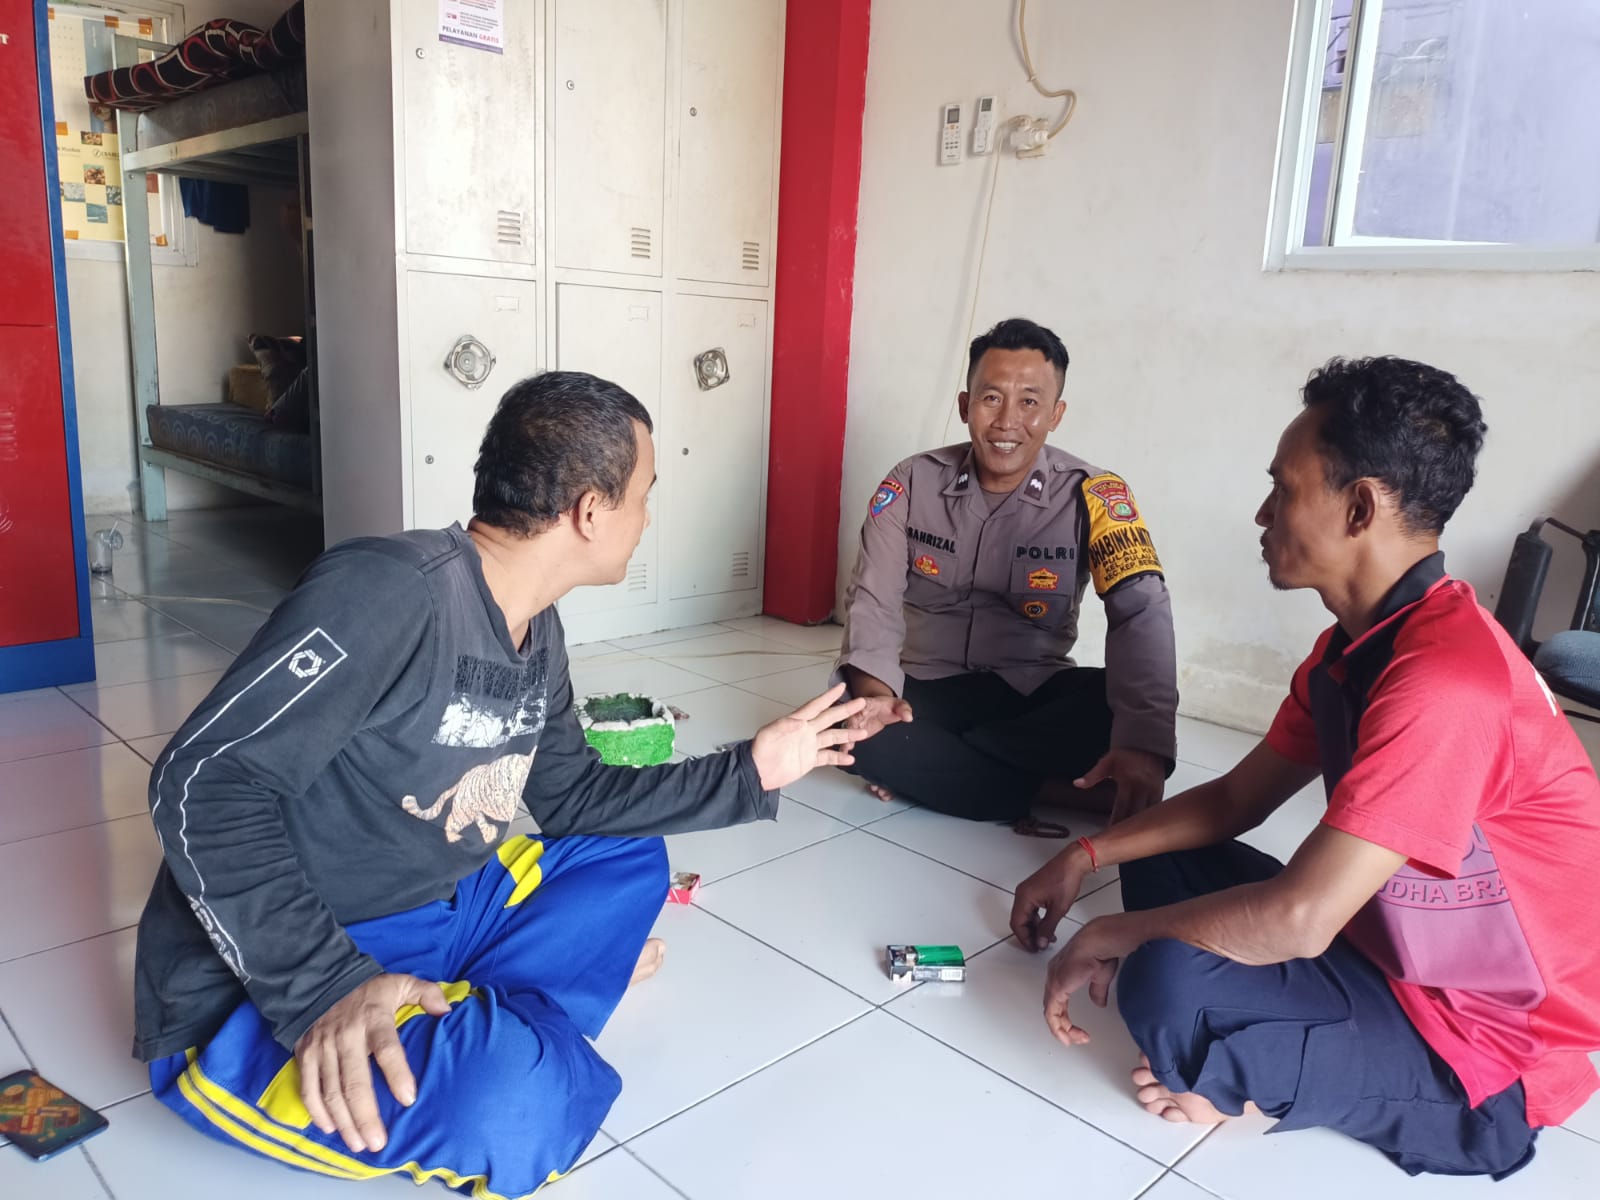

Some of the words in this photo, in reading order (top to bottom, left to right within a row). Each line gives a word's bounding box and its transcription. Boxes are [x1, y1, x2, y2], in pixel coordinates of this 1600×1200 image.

[442, 25, 478, 39] PELAYANAN
[479, 33, 500, 44] GRATIS
[1016, 546, 1075, 560] POLRI
[1102, 547, 1138, 568] PULAU
